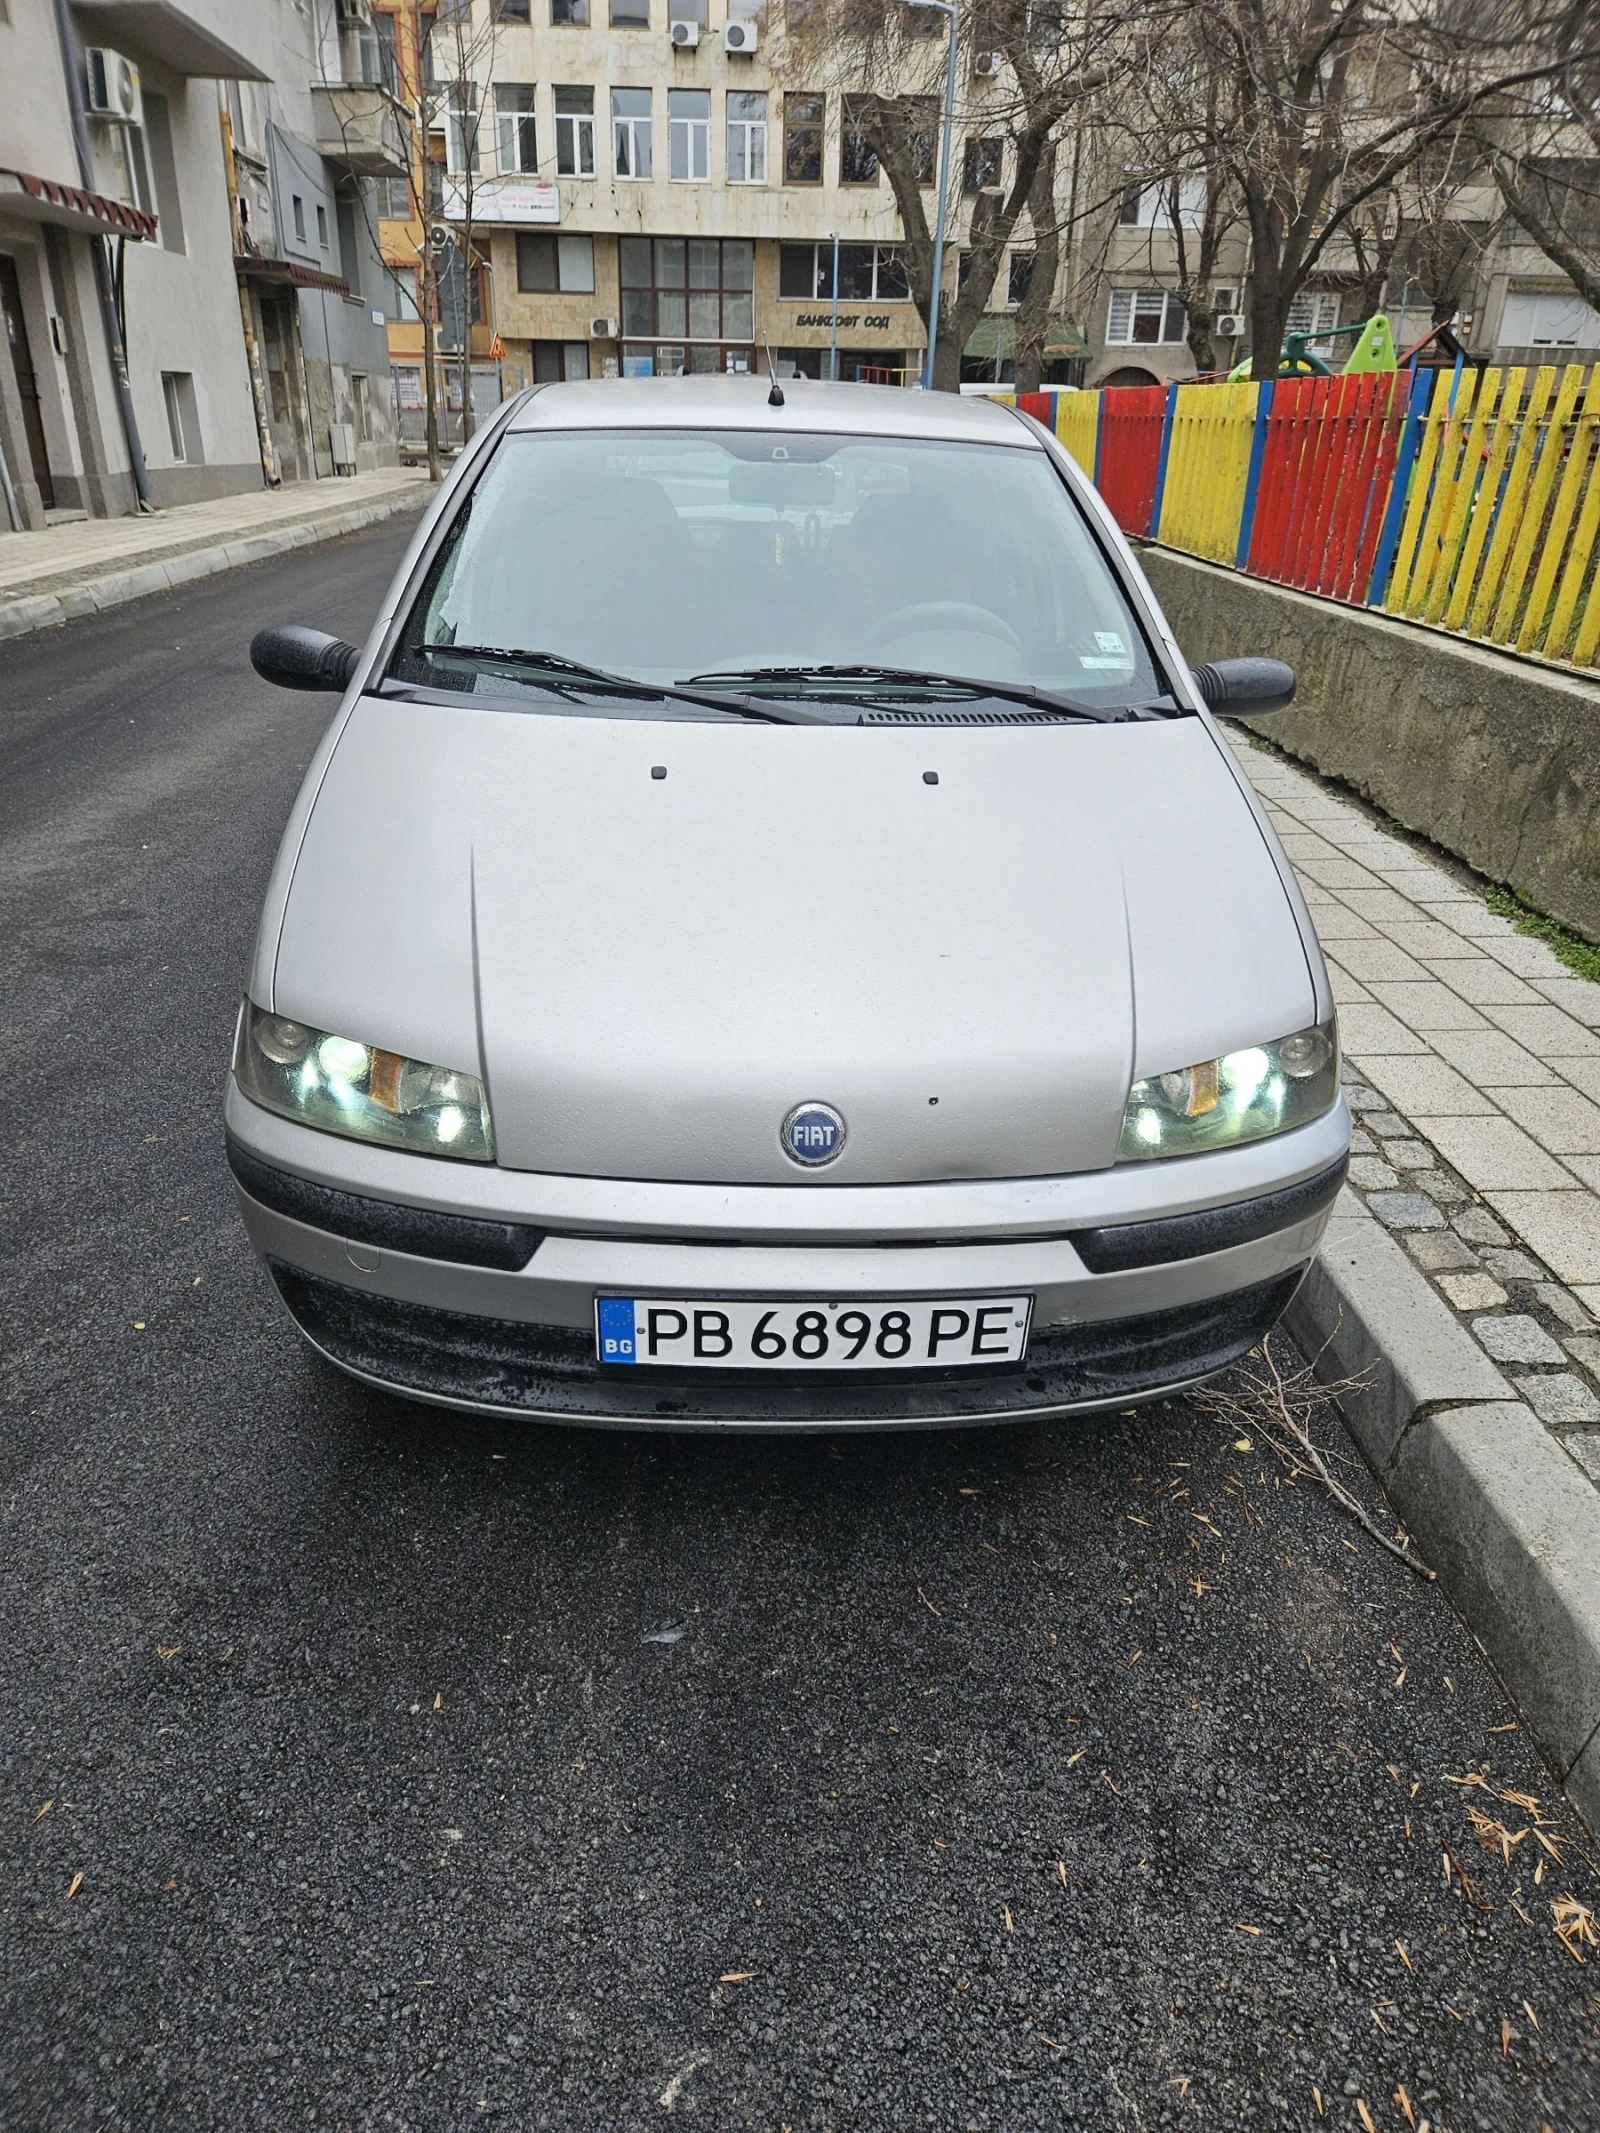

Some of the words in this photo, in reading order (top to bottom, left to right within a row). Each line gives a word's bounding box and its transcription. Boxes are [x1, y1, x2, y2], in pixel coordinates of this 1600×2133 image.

[796, 315, 860, 327] БАНКСОФТ
[864, 315, 890, 330] ООД
[793, 1126, 834, 1146] FIAT
[647, 1308, 733, 1358] PB
[750, 1311, 912, 1360] 6898
[926, 1306, 1014, 1358] PE
[605, 1338, 632, 1353] BG
